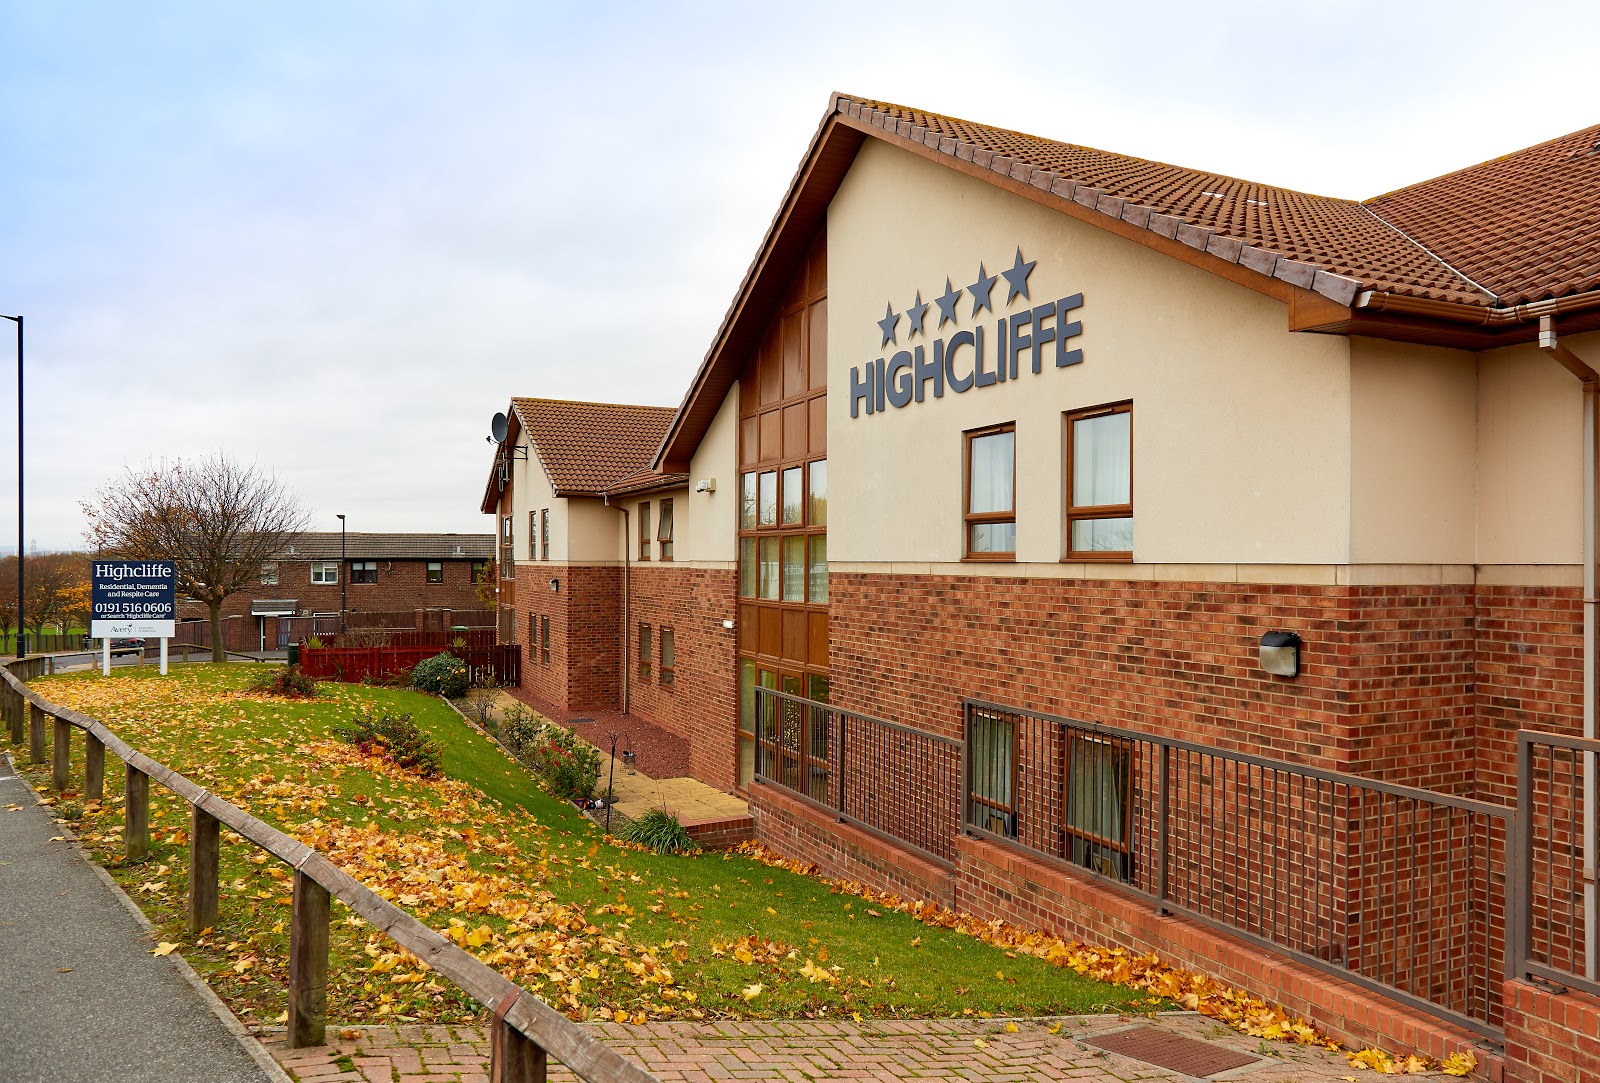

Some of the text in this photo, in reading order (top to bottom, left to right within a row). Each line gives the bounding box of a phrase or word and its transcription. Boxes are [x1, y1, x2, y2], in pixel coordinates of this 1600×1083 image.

[850, 292, 1083, 418] HIGHCLIFFE
[95, 564, 171, 580] Highcliffe
[95, 602, 172, 613] 0191 516 0606
[110, 626, 132, 634] Avery
